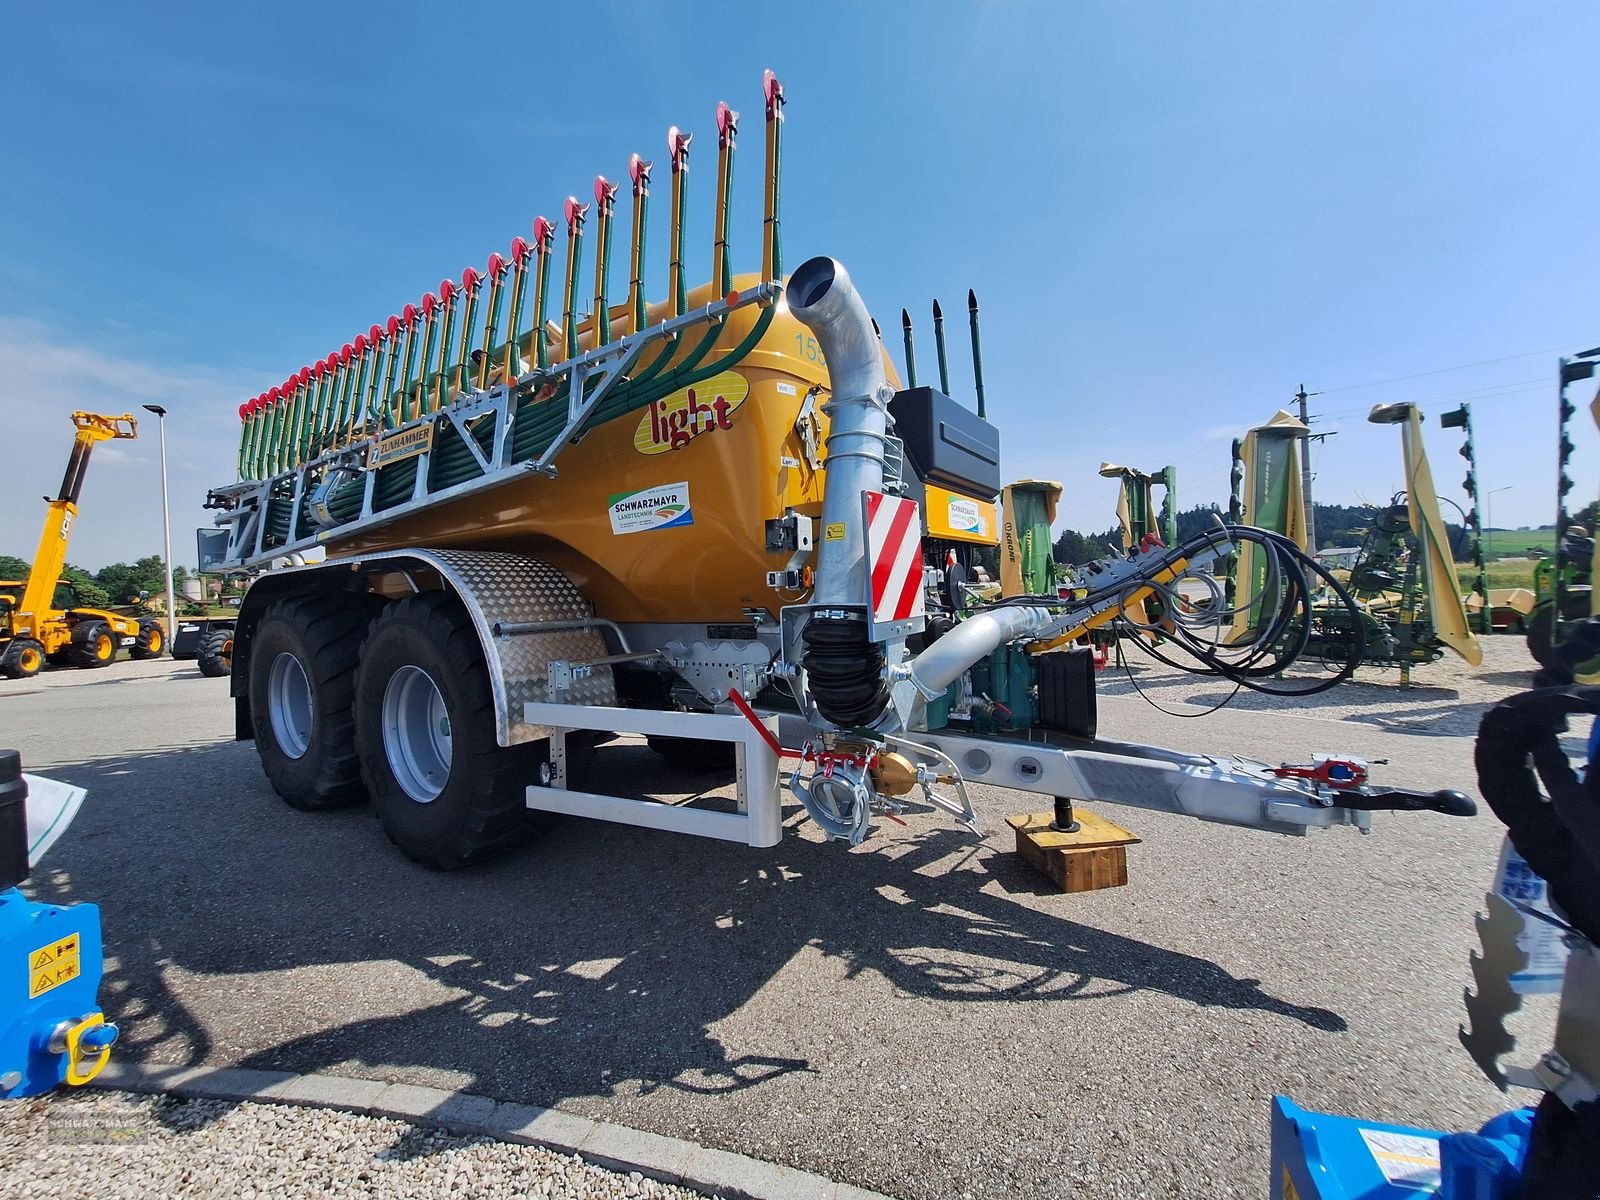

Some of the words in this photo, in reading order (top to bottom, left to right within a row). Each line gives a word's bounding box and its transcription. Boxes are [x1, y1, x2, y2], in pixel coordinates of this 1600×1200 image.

[649, 387, 733, 450] light
[381, 428, 430, 454] ZUNHAMMER
[615, 494, 678, 513] SCHWARZMAYR
[617, 510, 654, 521] LANDTECHNIK
[1005, 532, 1016, 563] KRONE
